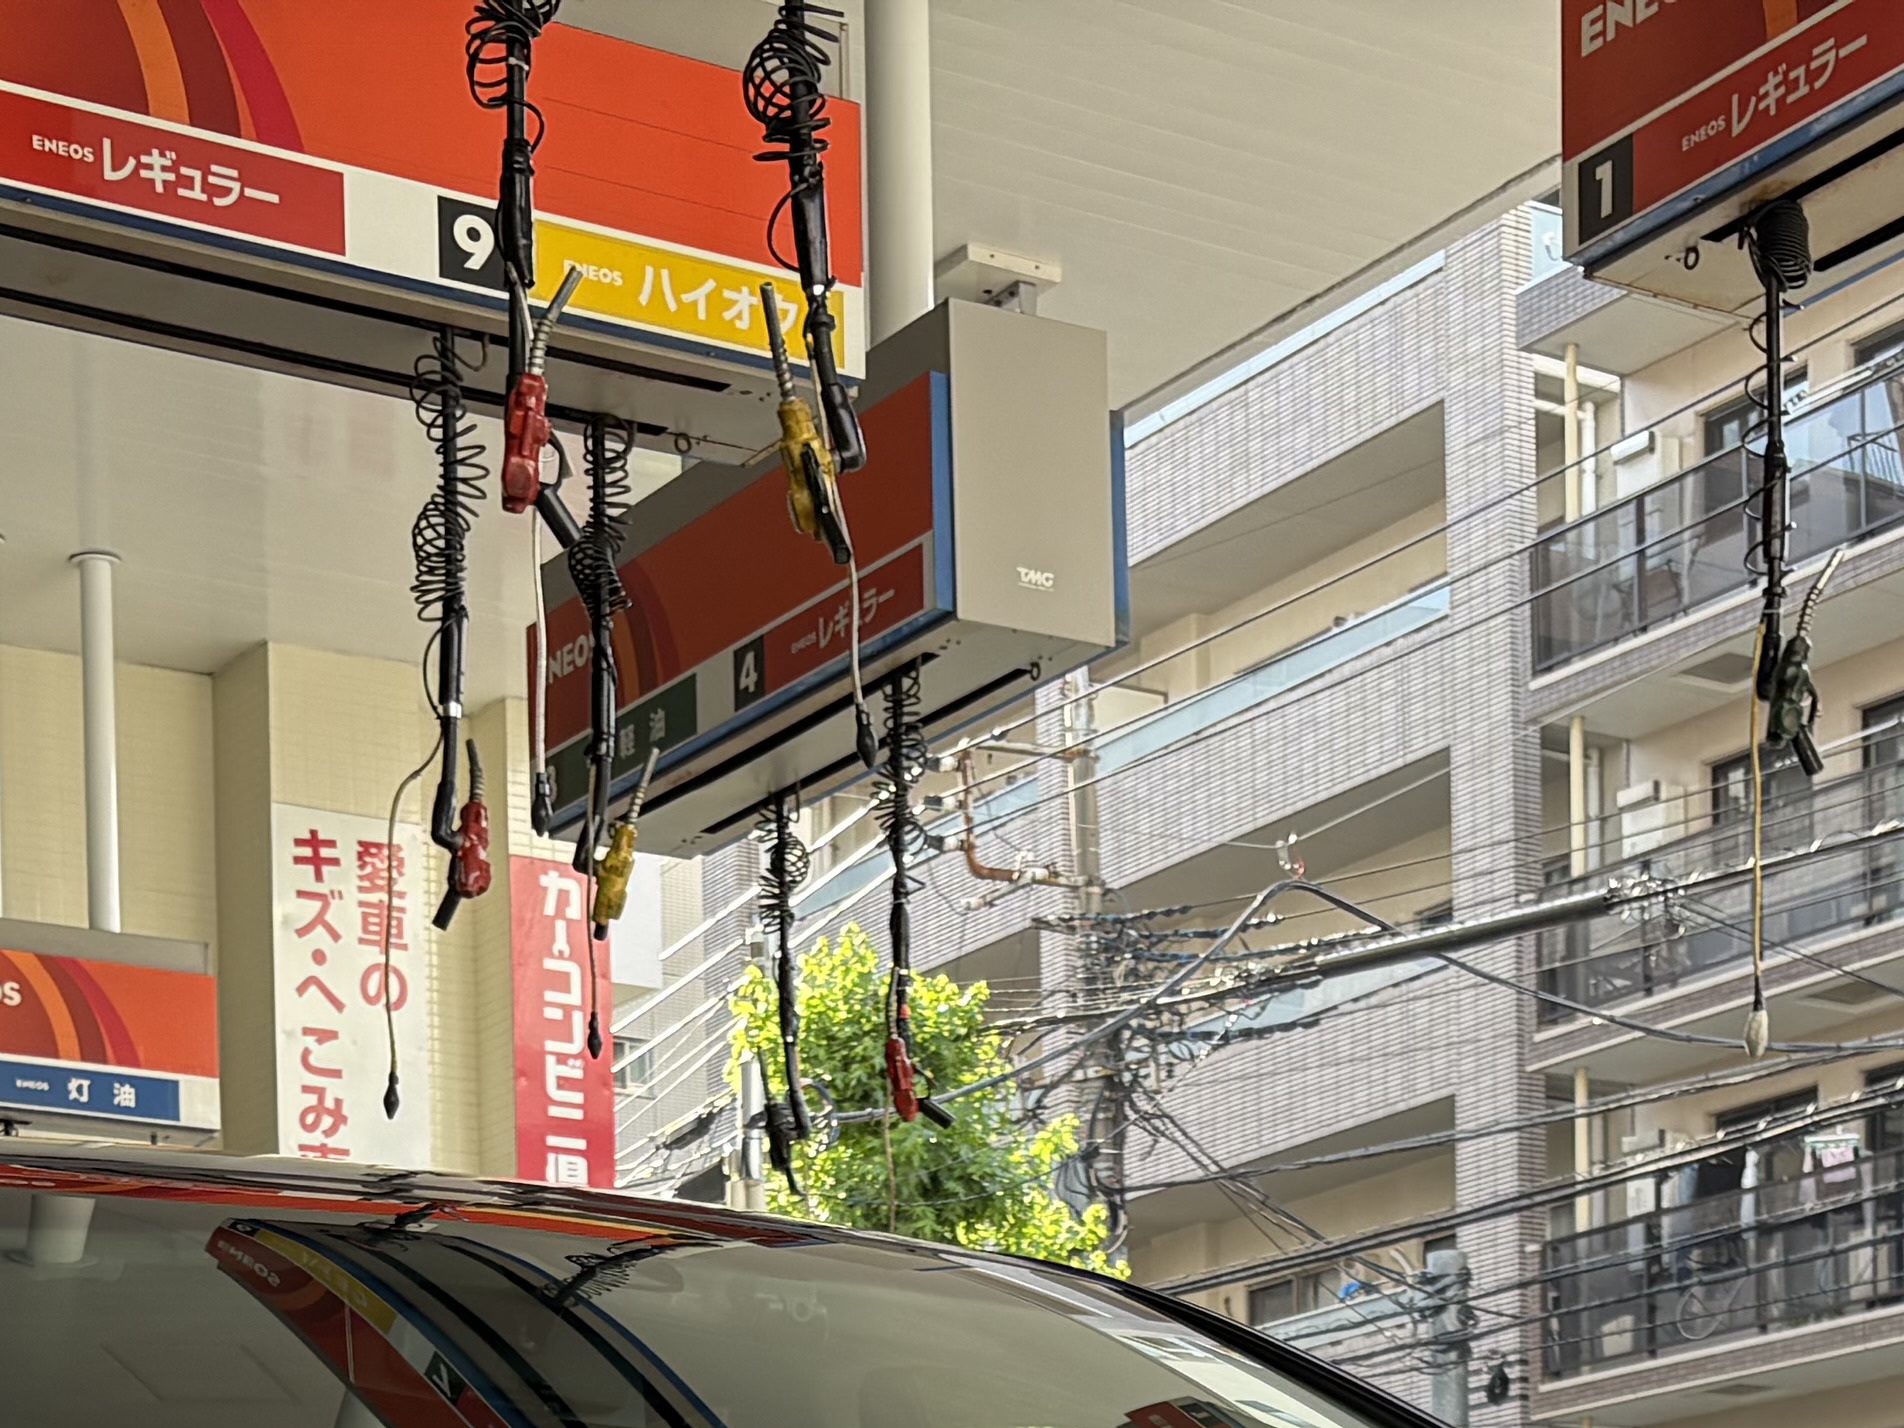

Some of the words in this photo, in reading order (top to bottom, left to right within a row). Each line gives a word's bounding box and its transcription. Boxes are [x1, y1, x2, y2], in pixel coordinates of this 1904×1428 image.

[1594, 159, 1613, 219] 1
[1681, 115, 1726, 152] ENEOS
[1730, 34, 1869, 138] レギュラー
[32, 132, 94, 165] ENEOS
[100, 138, 282, 210] レギュラー
[453, 213, 495, 271] 9
[739, 651, 758, 693] 4
[356, 840, 409, 1013] 愛車の
